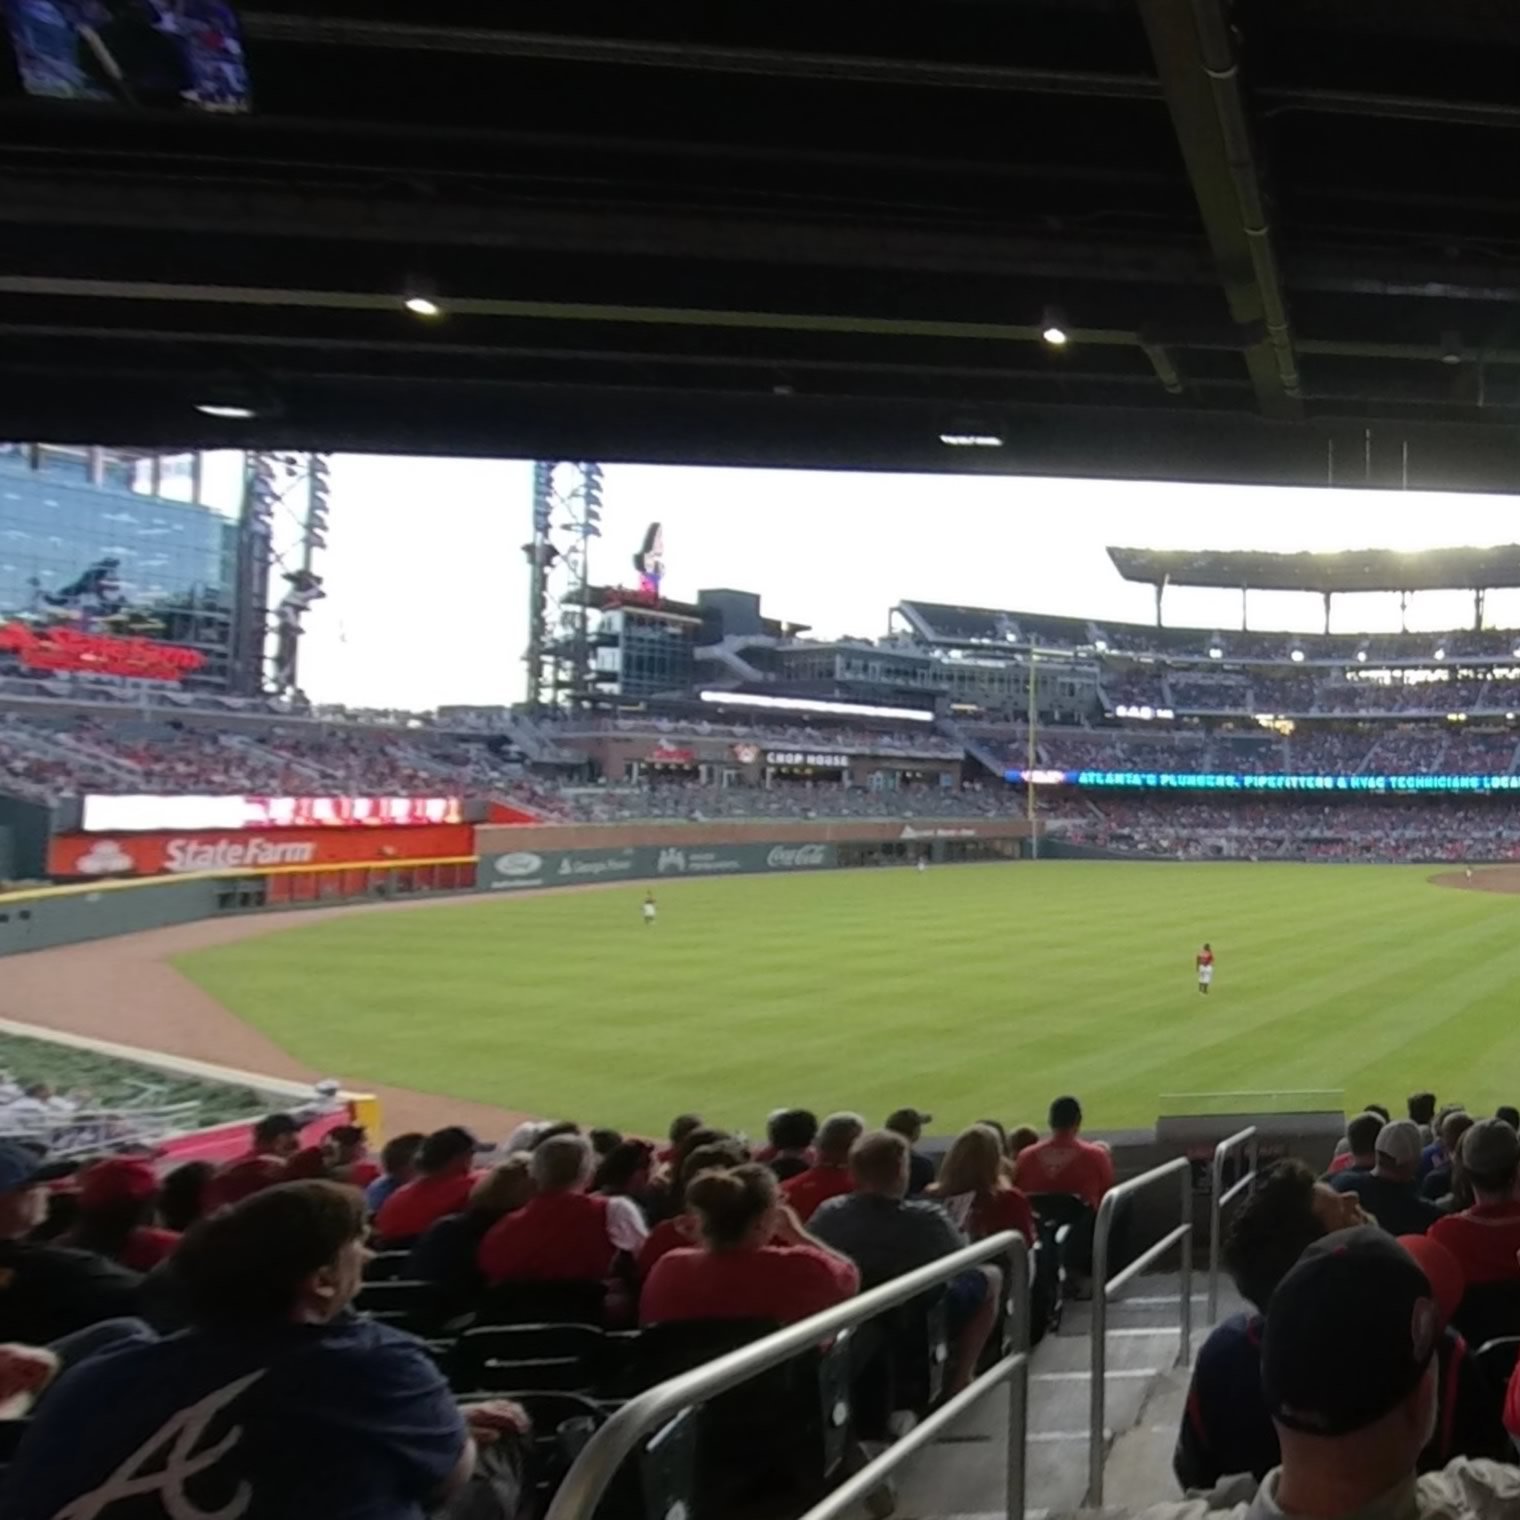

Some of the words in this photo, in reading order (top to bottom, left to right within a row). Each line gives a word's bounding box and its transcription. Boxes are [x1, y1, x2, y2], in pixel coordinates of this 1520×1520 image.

[766, 752, 802, 764] CHOP
[807, 753, 848, 767] HOUSE
[1078, 771, 1156, 785] ATLANTA'S
[1244, 775, 1333, 789] PIPEFITTERS
[1337, 776, 1348, 788] &
[1351, 776, 1386, 789] HVAC
[1390, 776, 1480, 788] TECHNICIANS
[52, 1368, 268, 1520] A
